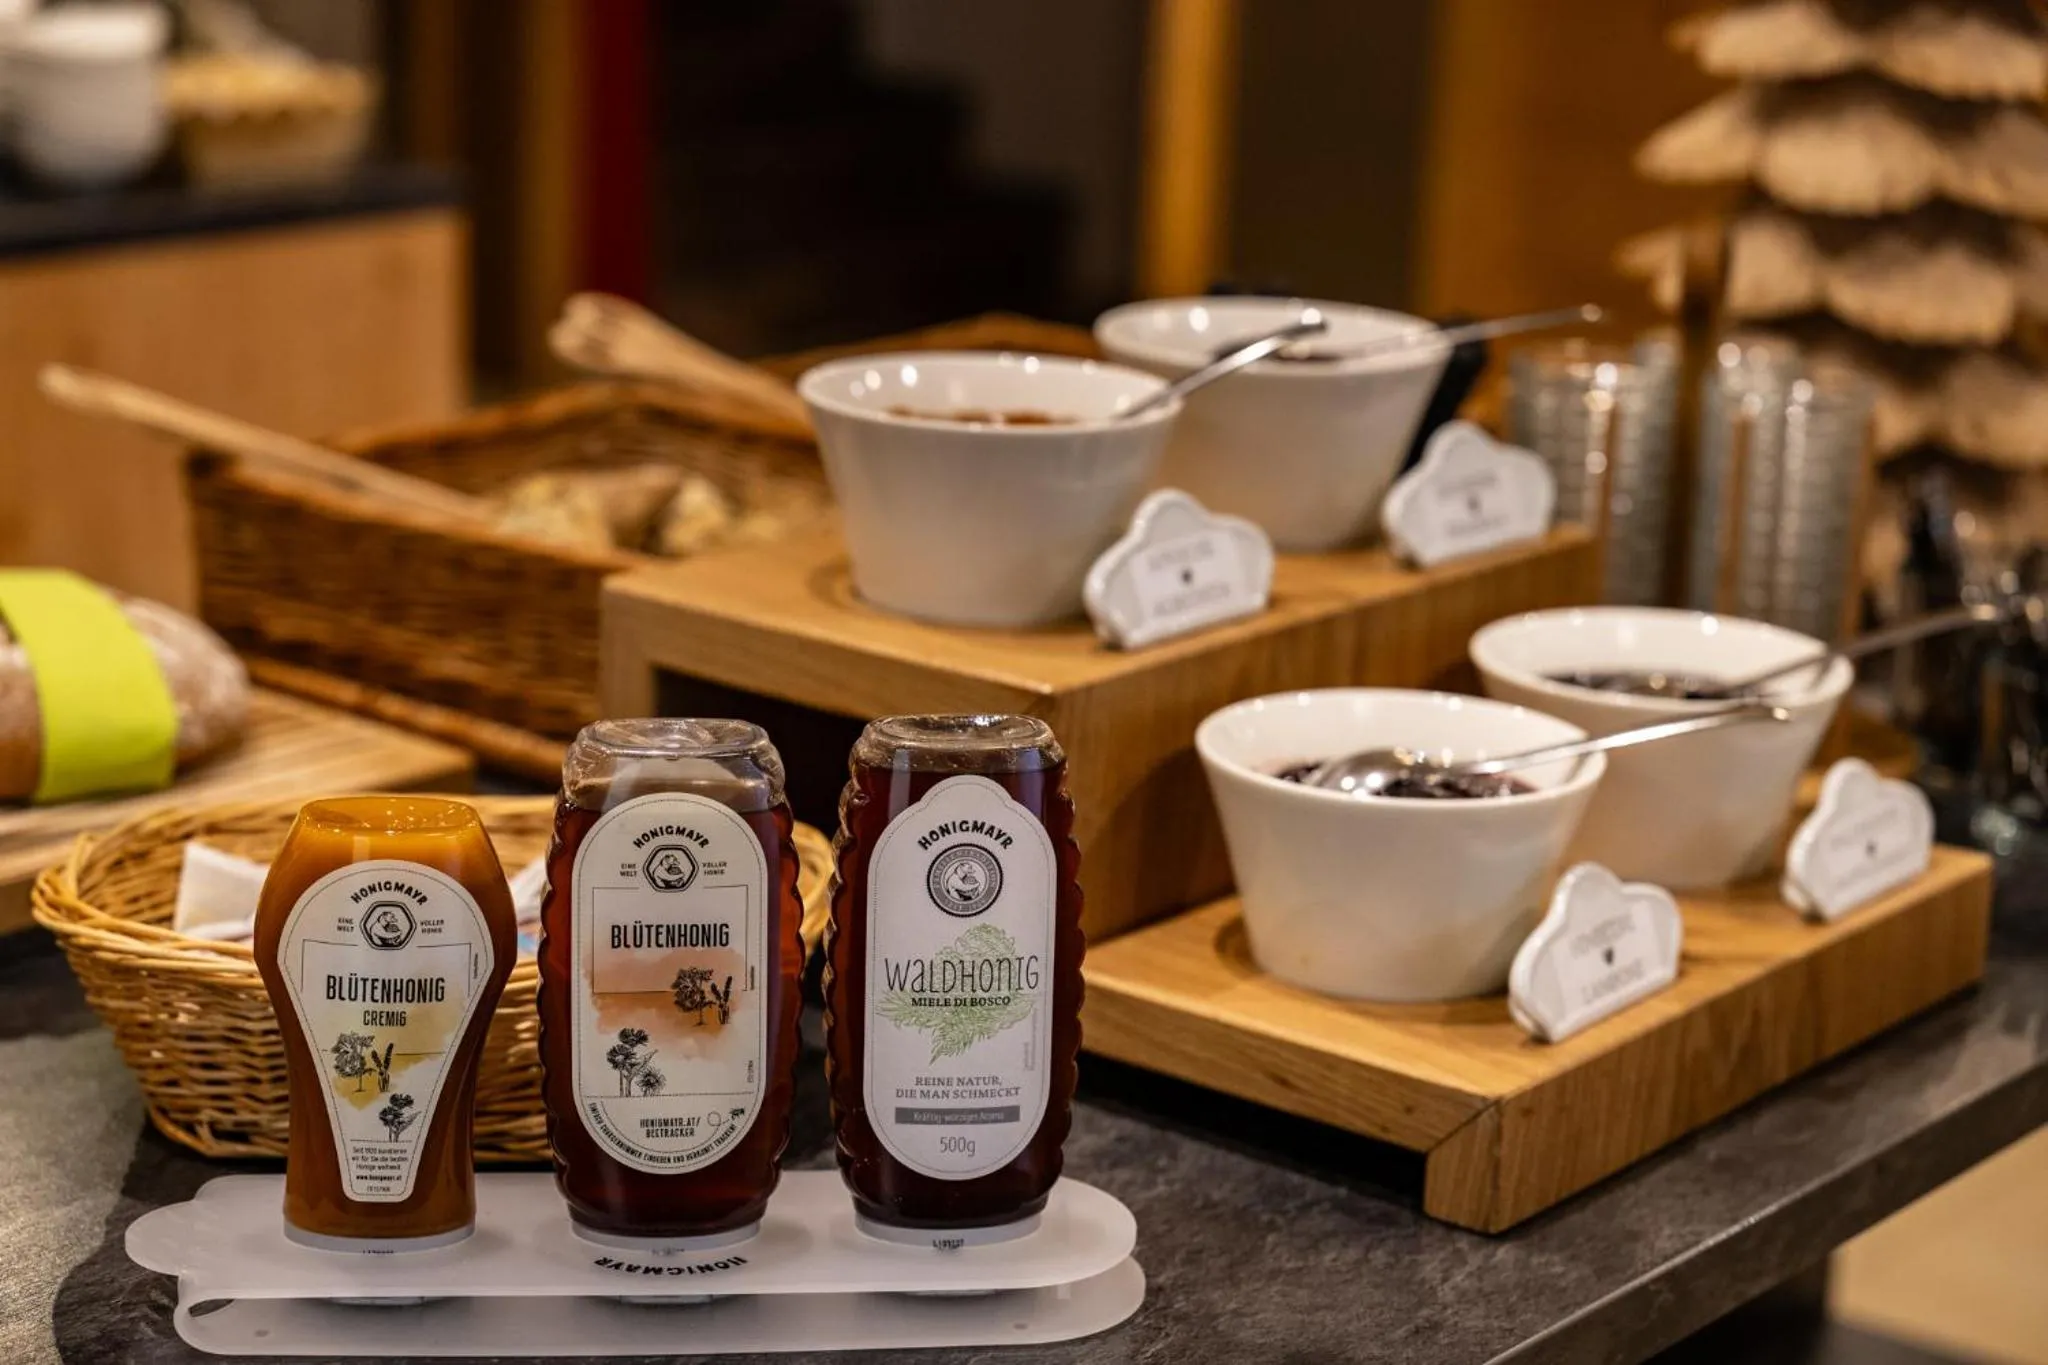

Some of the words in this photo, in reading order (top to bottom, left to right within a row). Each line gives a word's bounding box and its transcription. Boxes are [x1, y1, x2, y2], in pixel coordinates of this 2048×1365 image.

[632, 825, 710, 849] HONIGMAYR
[917, 820, 1014, 850] HONIGMAYR
[620, 870, 638, 878] WELT
[350, 881, 428, 906] HONIGMAYR
[337, 924, 354, 933] WELT
[420, 919, 445, 927] VOLLER
[421, 926, 443, 935] HONIG
[611, 920, 730, 949] BLÜTENHONIG
[326, 973, 446, 1003] BLÜTENHONIG
[911, 997, 951, 1007] MIELE
[954, 997, 968, 1007] DI
[970, 996, 1011, 1007] BOSCO
[363, 1010, 407, 1026] CREMIG
[914, 1076, 953, 1087] REINE
[895, 1088, 917, 1099] DIE
[920, 1088, 950, 1099] MAN
[952, 1086, 1021, 1099] SCHMECKT
[646, 1127, 695, 1138] BEETRACKER
[940, 1136, 976, 1158] 500g
[673, 1155, 685, 1164] UND
[594, 1256, 748, 1276] HONIGMAYR
